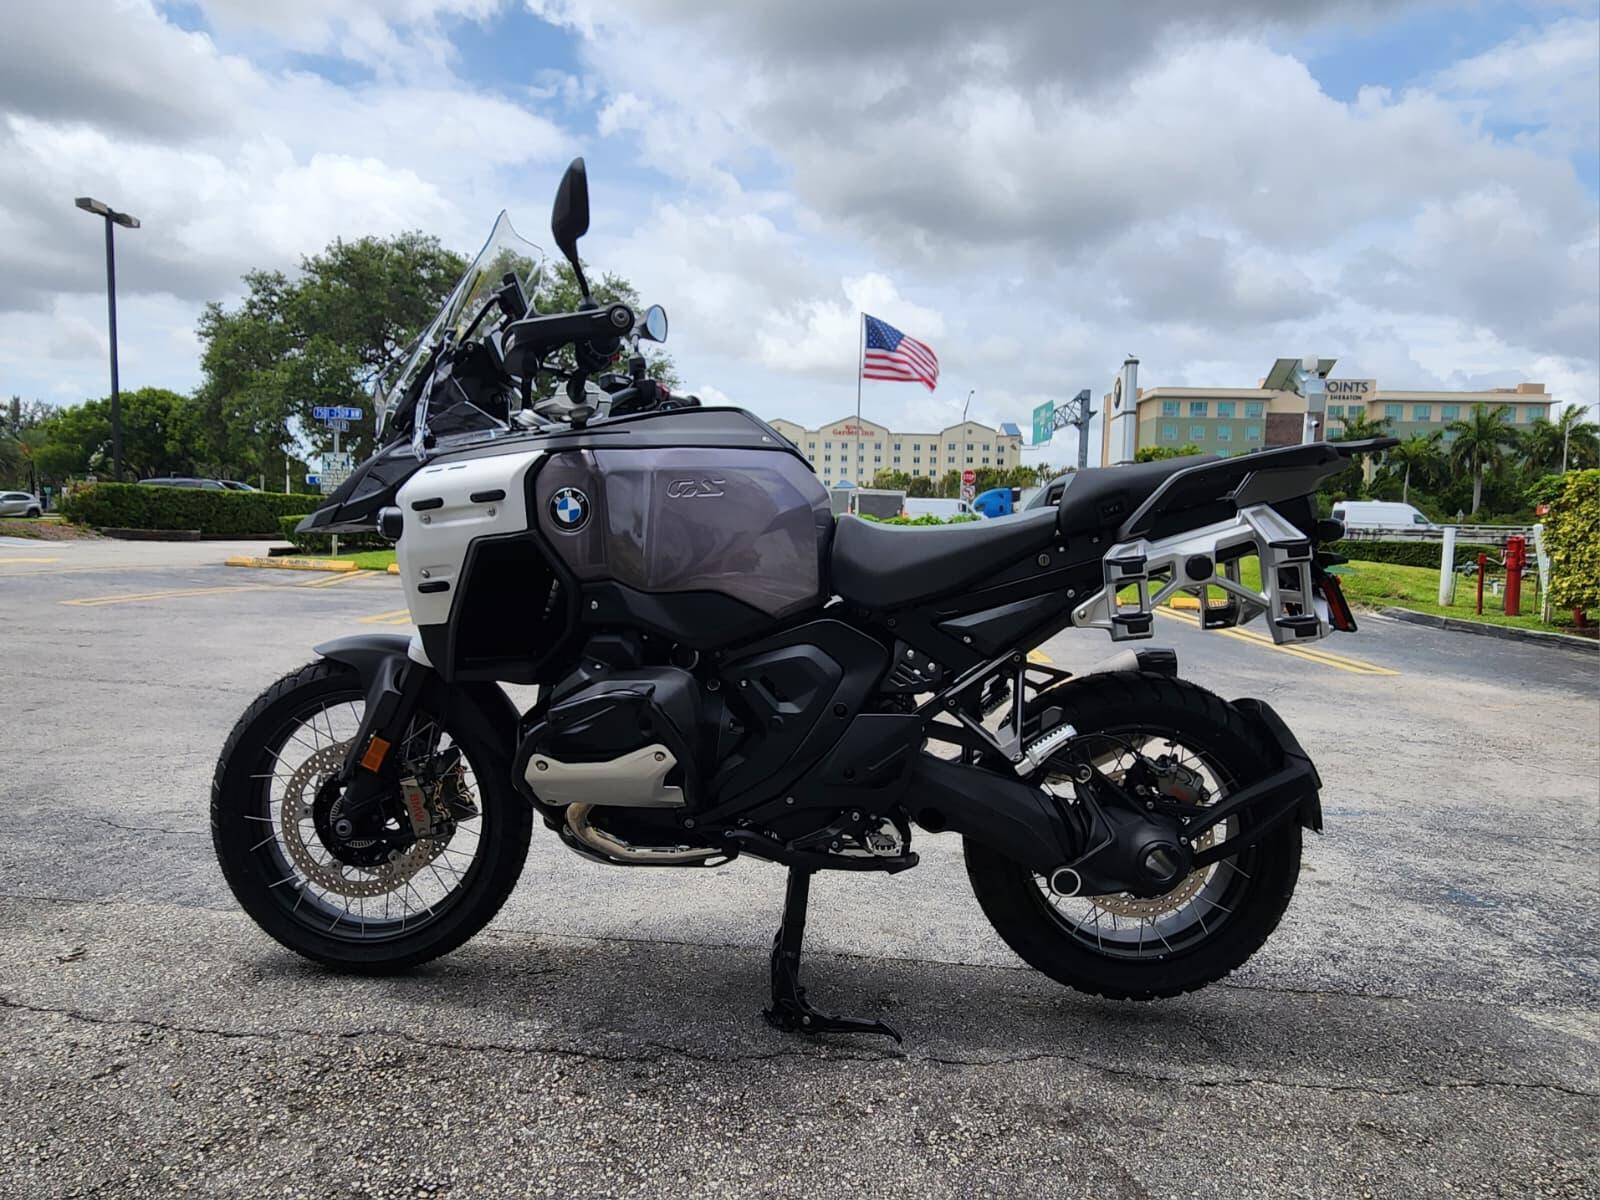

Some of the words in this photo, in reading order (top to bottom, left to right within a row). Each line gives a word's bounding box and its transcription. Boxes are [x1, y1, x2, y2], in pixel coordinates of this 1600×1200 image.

[553, 490, 585, 505] BMW
[667, 479, 726, 498] GS
[410, 793, 425, 822] BMW
